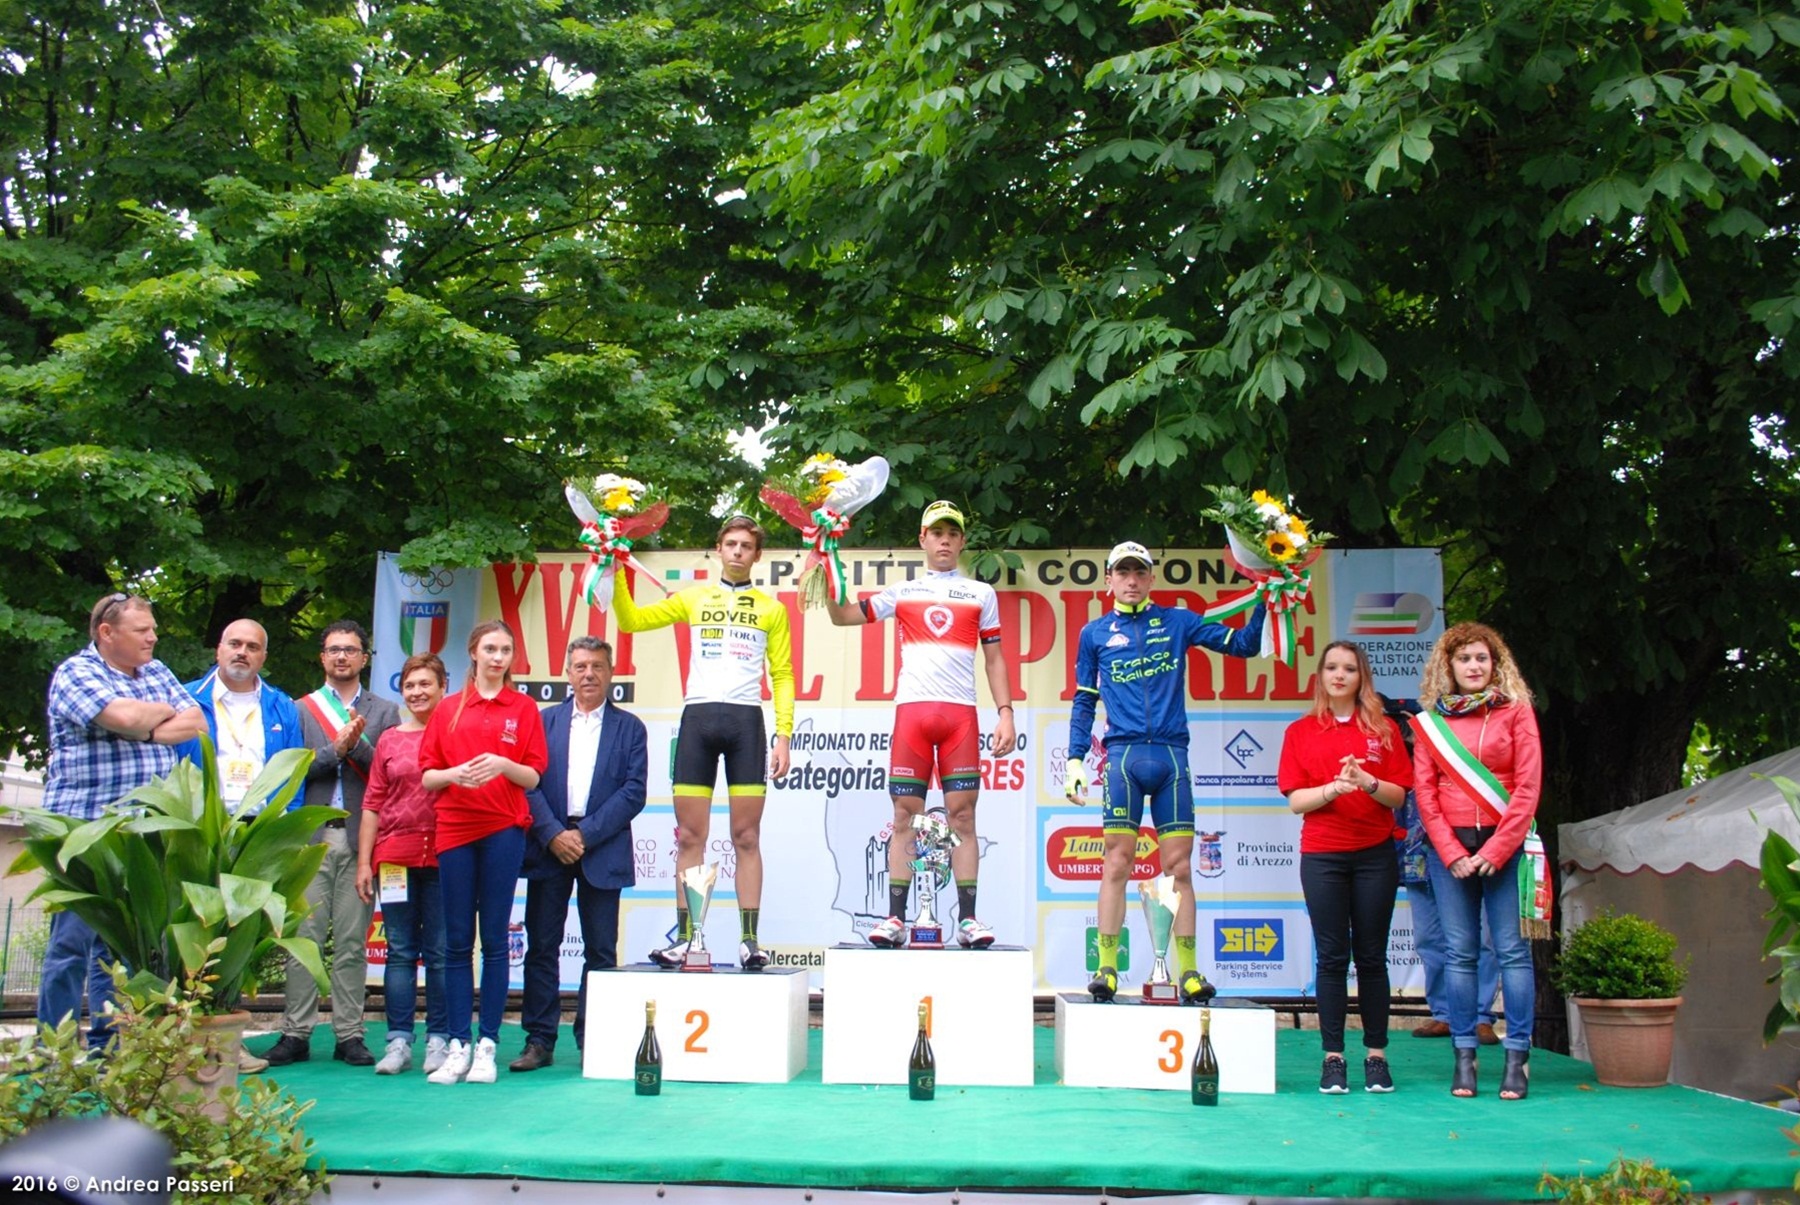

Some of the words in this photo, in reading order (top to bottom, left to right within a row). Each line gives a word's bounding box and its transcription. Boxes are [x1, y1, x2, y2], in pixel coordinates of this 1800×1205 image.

[840, 561, 924, 586] ITT
[404, 605, 445, 615] ITALIA
[701, 610, 758, 626] DOVER
[994, 590, 1318, 701] PIRLE
[1354, 641, 1433, 652] DERAZIONE
[1111, 651, 1170, 673] Franco
[1367, 654, 1425, 664] CLISTICA
[1111, 658, 1179, 683] Ballerini
[1371, 666, 1419, 677] ALIANA
[1236, 745, 1255, 761] bpc
[1195, 776, 1219, 784] banca
[1221, 776, 1254, 786] popolare
[1256, 776, 1264, 784] di
[1236, 842, 1293, 853] Provincia
[1236, 856, 1249, 866] di
[1252, 857, 1293, 867] Arezzo
[764, 950, 825, 967] Mercatal
[1216, 962, 1248, 971] Parking
[1250, 962, 1283, 971] Service
[1230, 970, 1268, 979] Systems
[685, 1010, 709, 1053] 2
[1158, 1029, 1184, 1073] 3
